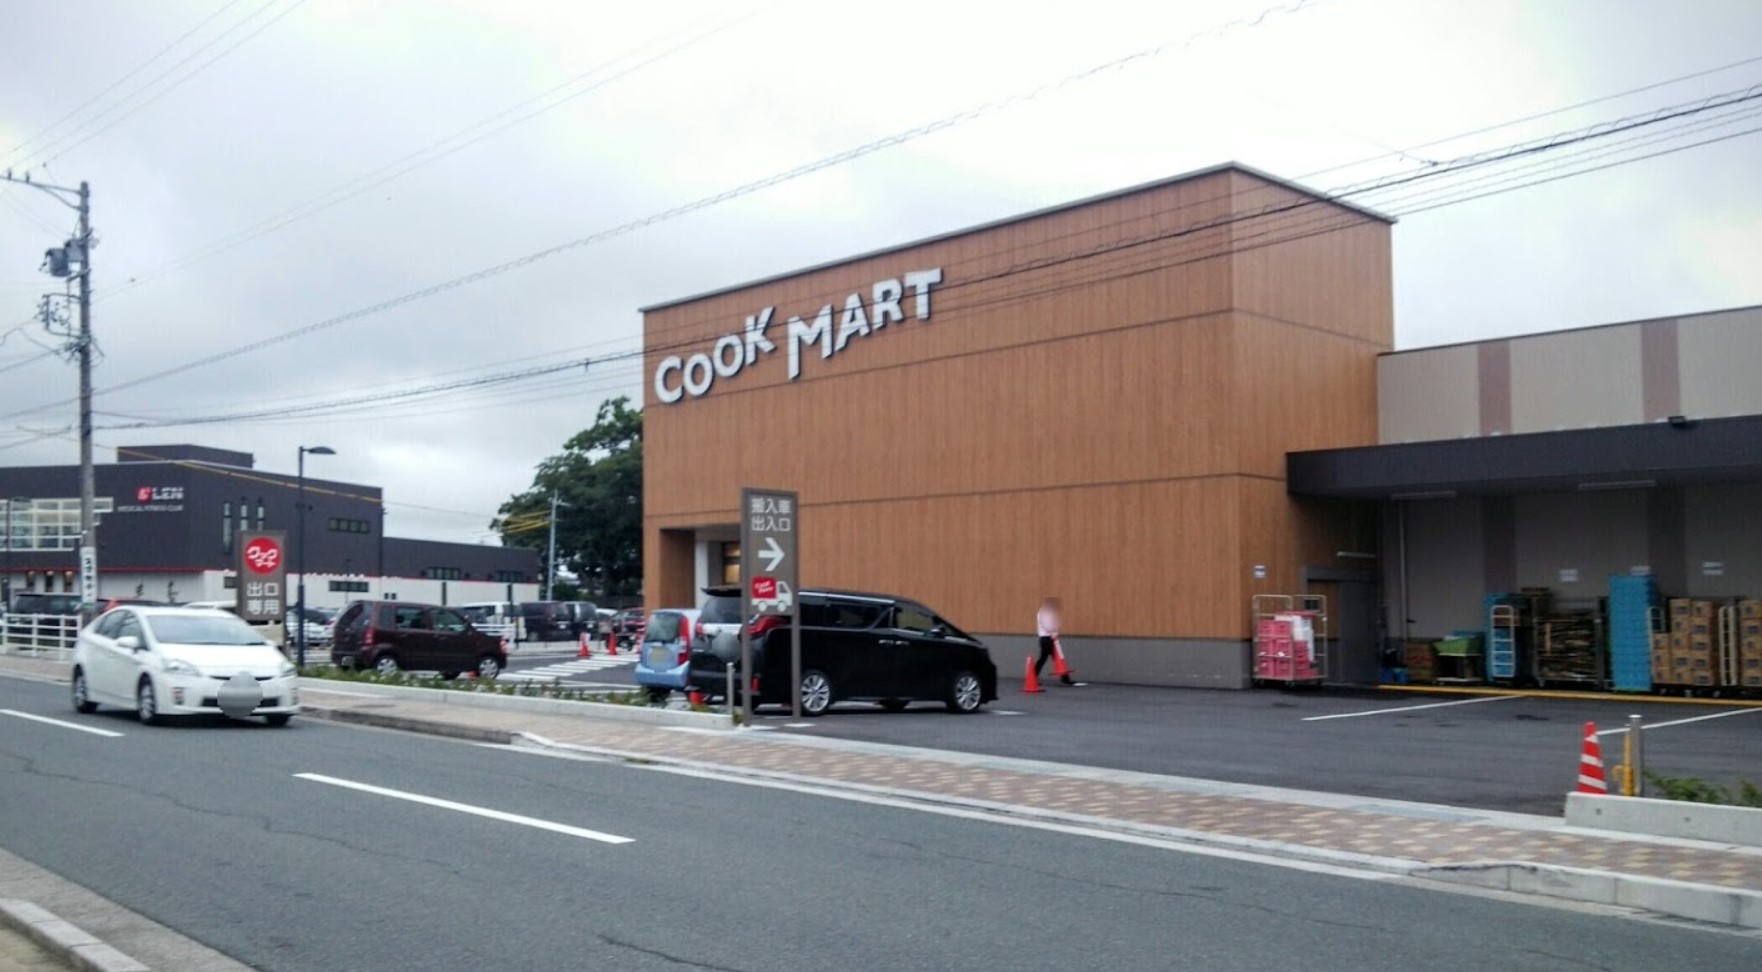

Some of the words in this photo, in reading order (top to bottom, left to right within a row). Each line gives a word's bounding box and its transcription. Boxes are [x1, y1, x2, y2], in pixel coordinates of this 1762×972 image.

[655, 306, 777, 403] COOK
[788, 268, 943, 380] MART
[751, 516, 791, 532] 出入口
[246, 582, 279, 597] 出口
[246, 599, 280, 615] 専用
